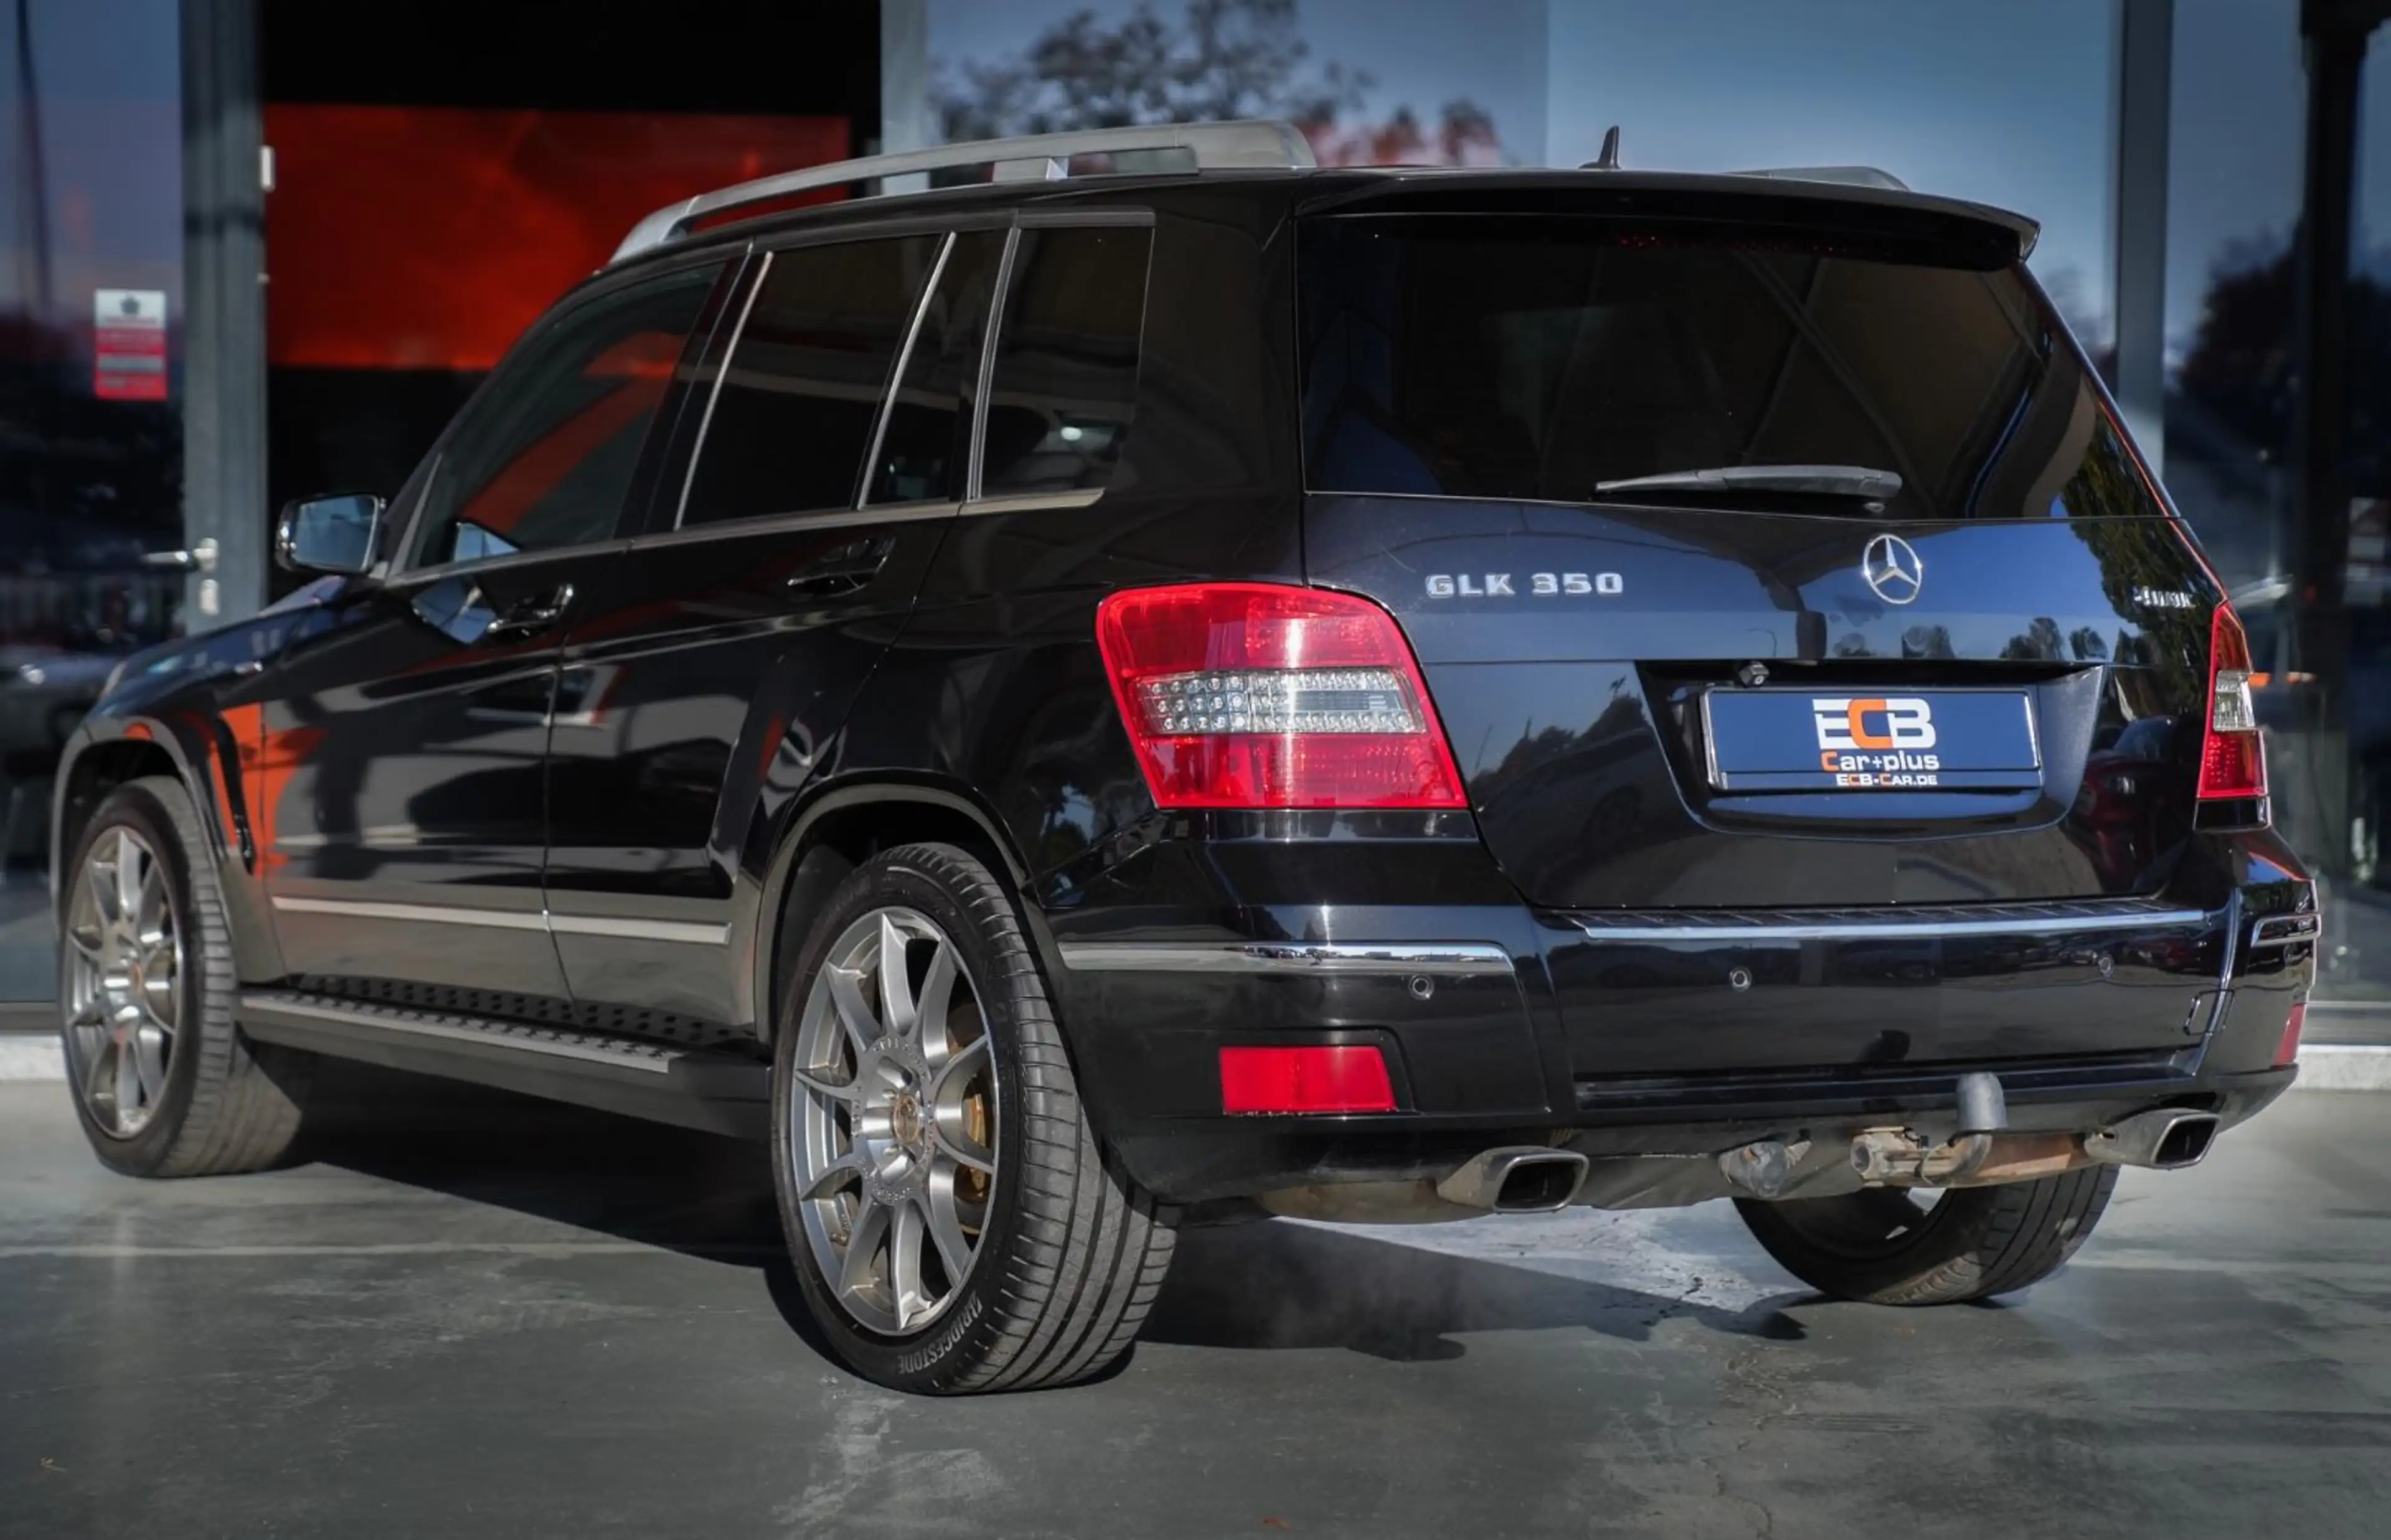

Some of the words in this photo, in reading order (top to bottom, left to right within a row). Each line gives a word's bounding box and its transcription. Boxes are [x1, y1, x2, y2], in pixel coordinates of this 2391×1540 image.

[1425, 573, 1516, 598] GLK
[1531, 572, 1623, 597] 350
[1812, 698, 1936, 750] ECB
[1821, 750, 1940, 772] Car+plus
